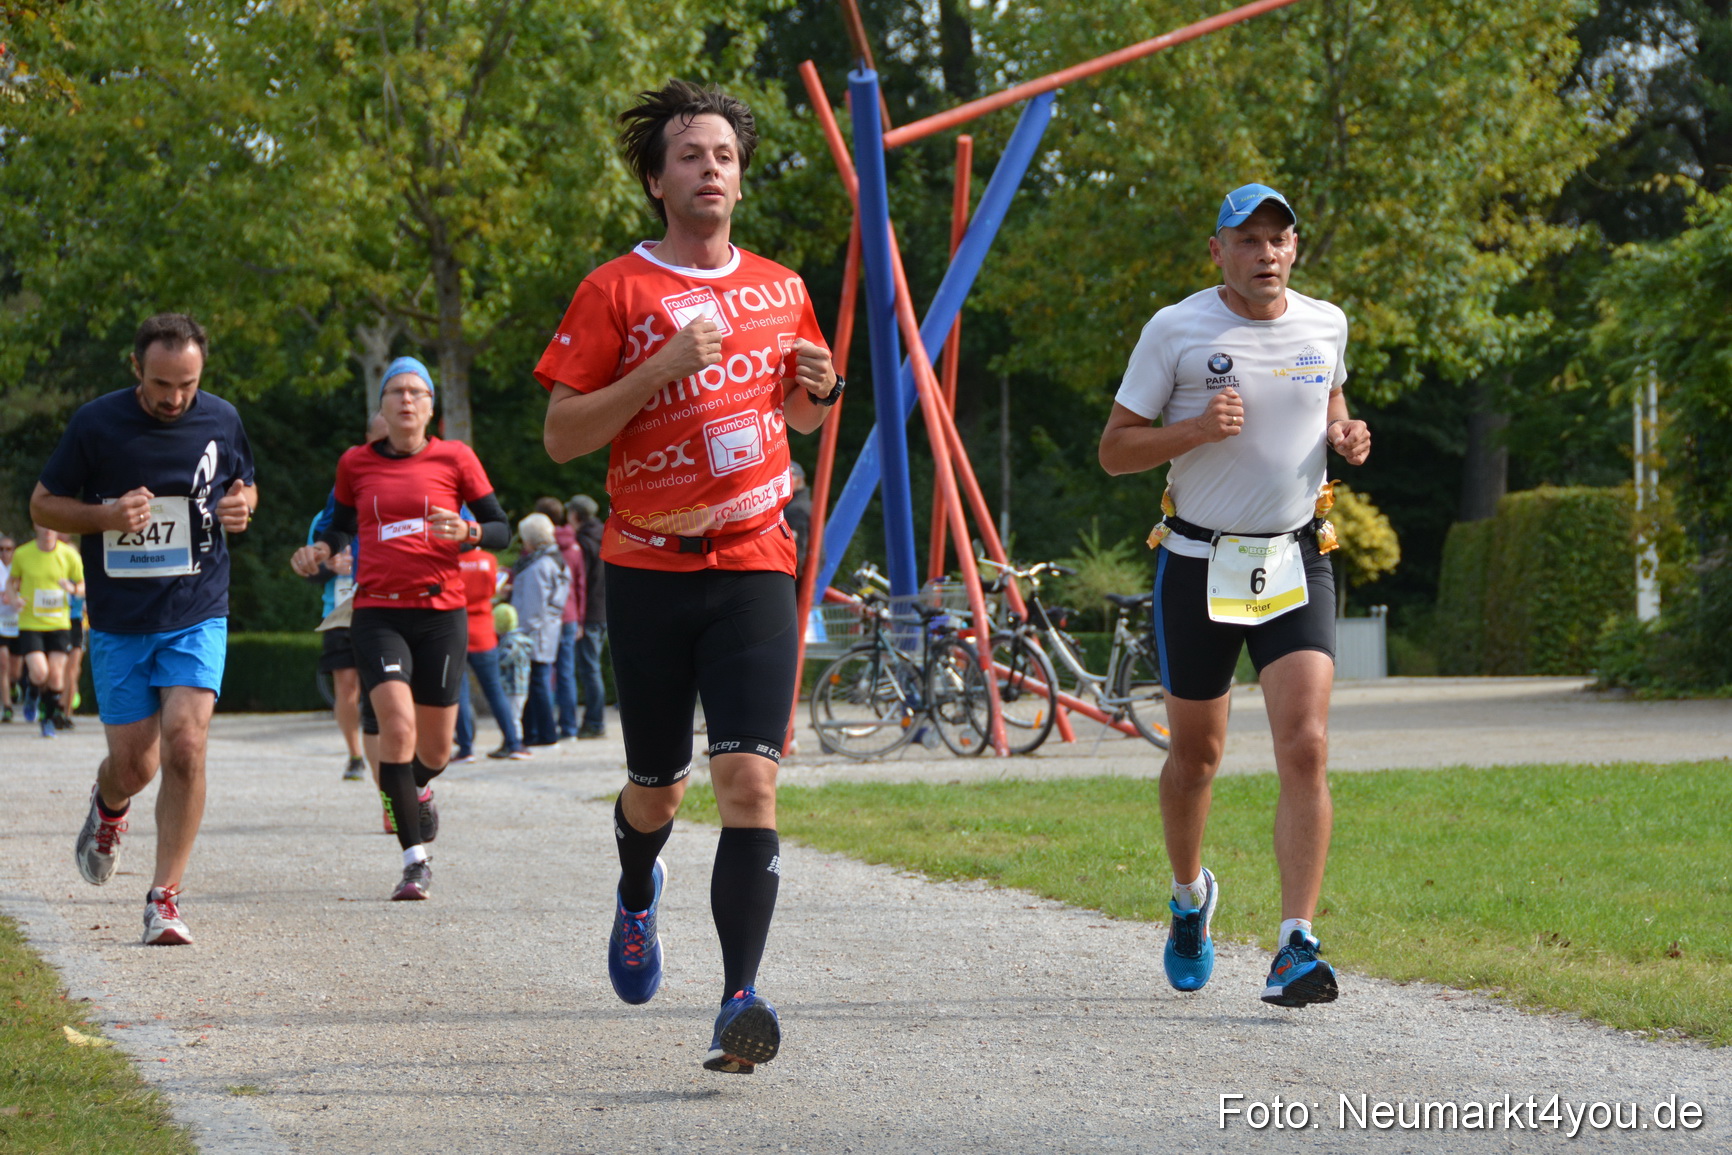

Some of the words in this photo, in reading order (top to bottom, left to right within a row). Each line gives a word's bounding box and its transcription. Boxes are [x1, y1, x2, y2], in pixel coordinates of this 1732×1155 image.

[667, 291, 713, 309] raumbox
[739, 313, 789, 332] schenken
[1206, 376, 1240, 384] PARTL
[670, 397, 724, 421] wohnen
[733, 381, 777, 402] outdoor
[707, 415, 755, 437] raumbox
[646, 473, 698, 490] outdoor
[392, 524, 412, 533] DEHN
[129, 554, 166, 564] Andreas
[1249, 567, 1267, 595] 6
[1245, 602, 1271, 613] Peter
[714, 740, 741, 751] cep
[634, 774, 658, 786] cep
